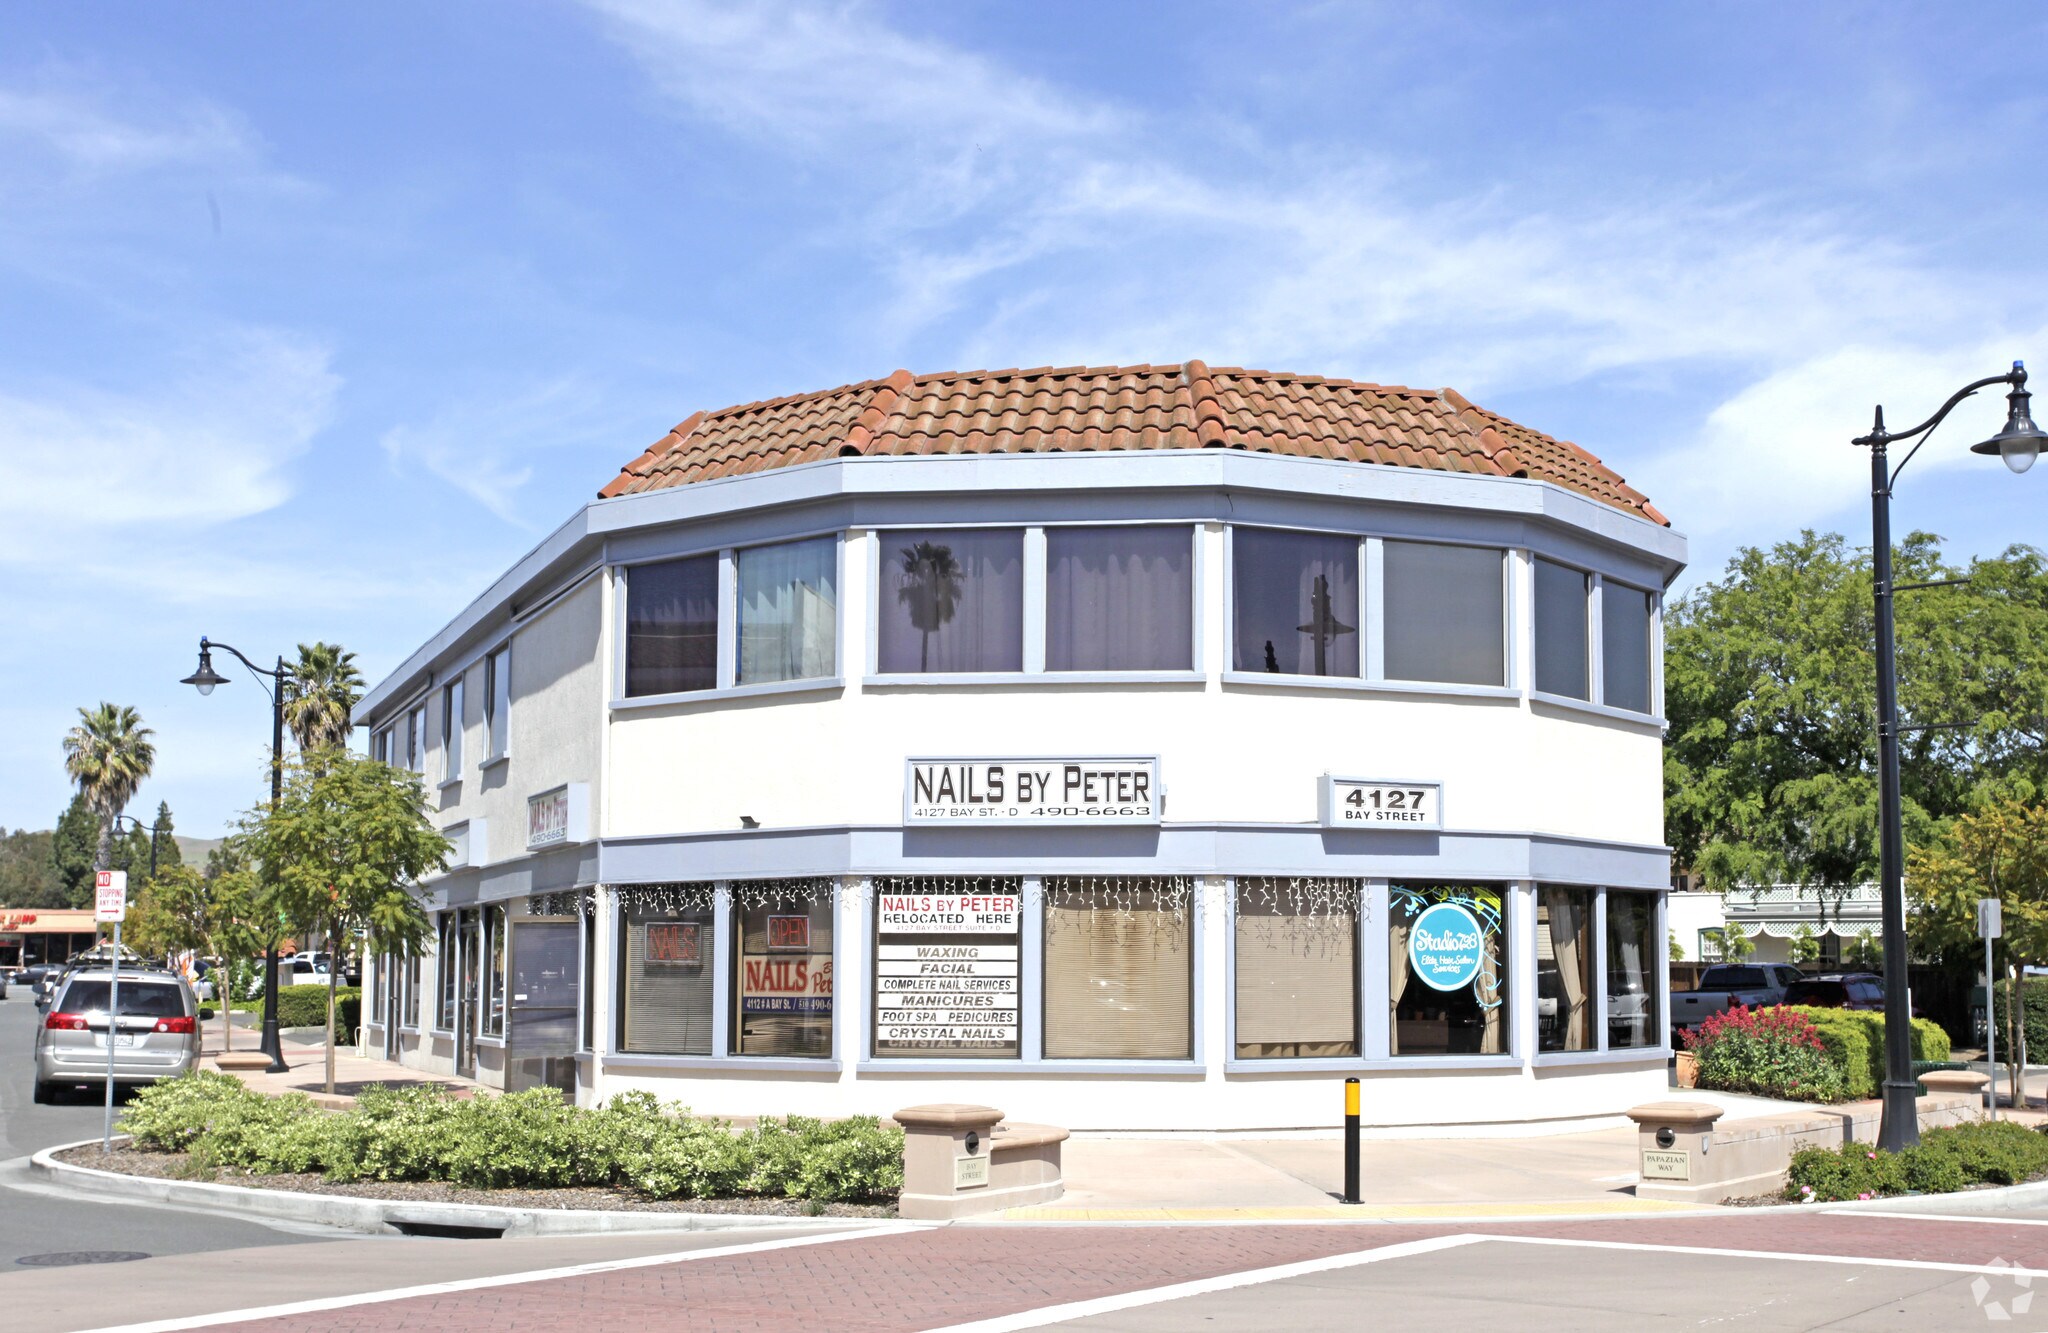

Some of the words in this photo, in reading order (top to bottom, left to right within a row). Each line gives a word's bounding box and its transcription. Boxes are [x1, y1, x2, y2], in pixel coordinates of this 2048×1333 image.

[914, 765, 1004, 804] NAILS
[1017, 771, 1051, 802] BY
[1064, 765, 1150, 803] PETER
[1346, 789, 1424, 809] 4127
[914, 808, 945, 817] 4127
[950, 808, 976, 817] BAY
[979, 808, 998, 817] ST.
[1009, 808, 1018, 816] D
[1030, 807, 1150, 816] 490-6663
[1345, 810, 1370, 820] BAY
[1376, 811, 1425, 821] STREET
[531, 827, 565, 843] 490-6663
[98, 873, 110, 886] NO
[99, 888, 123, 898] STOPPING
[883, 897, 930, 912] NAILS
[937, 900, 954, 912] BY
[961, 897, 1014, 912] PETER
[884, 914, 964, 924] RELOCATED
[976, 914, 1012, 924] HERE
[770, 918, 808, 947] OPEN
[650, 926, 695, 959] NAILS
[917, 947, 979, 958] WAXING
[920, 963, 976, 974] FACIAL
[745, 960, 808, 993] NAILS
[884, 979, 936, 990] COMPLETE
[939, 979, 961, 990] NAIL
[964, 980, 1011, 990] SERVICES
[747, 998, 760, 1009] 4112
[771, 998, 782, 1009] BAY
[901, 995, 994, 1006] MANICURES
[882, 1012, 912, 1022] FOOT
[915, 1012, 937, 1022] SPA
[948, 1012, 1013, 1022] PEDICURES
[889, 1028, 956, 1038] CRYSTAL
[961, 1028, 1006, 1038] NAILS
[1646, 1155, 1685, 1163] PAPAZIAN
[962, 1171, 982, 1180] STREET
